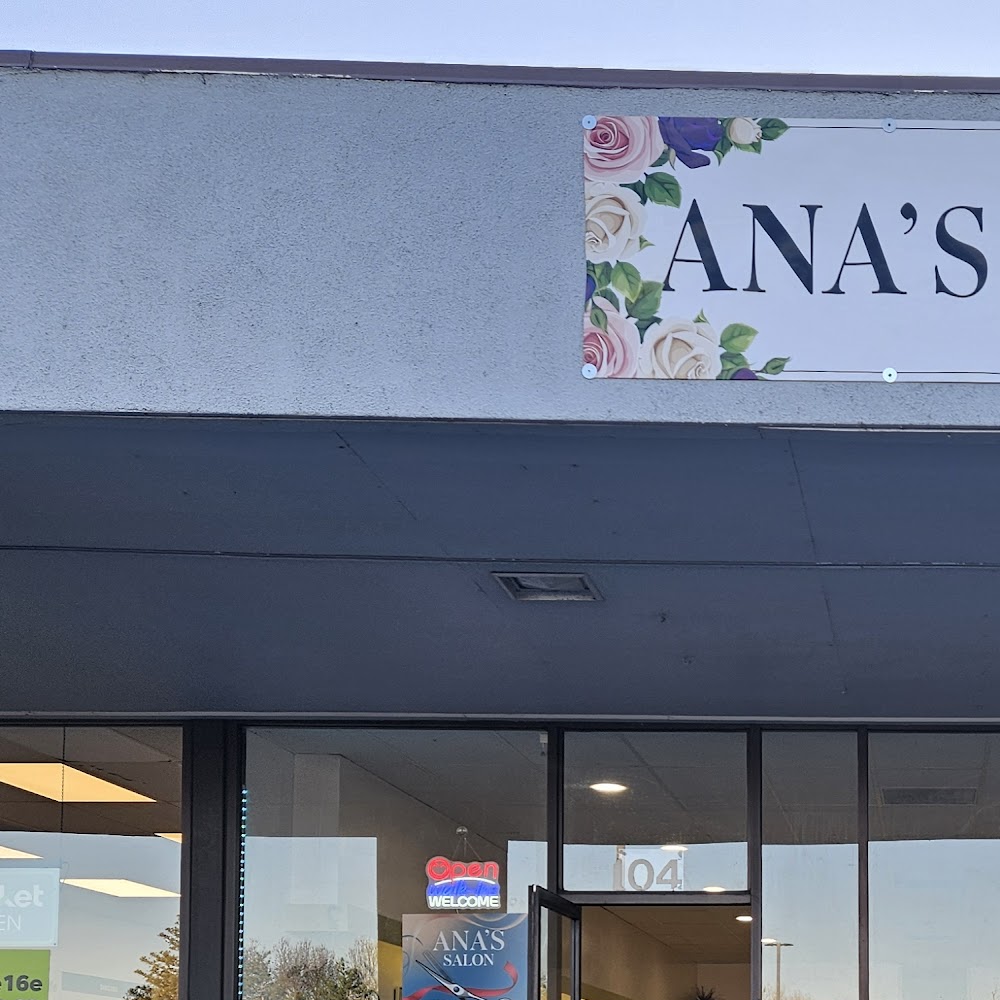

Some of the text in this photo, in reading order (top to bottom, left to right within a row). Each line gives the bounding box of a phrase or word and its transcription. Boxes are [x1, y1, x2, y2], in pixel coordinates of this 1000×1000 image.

[662, 198, 988, 298] ANA'S
[427, 857, 499, 882] Open
[428, 895, 501, 908] WELCOME
[433, 930, 505, 951] ANA'S
[443, 953, 494, 967] SALON
